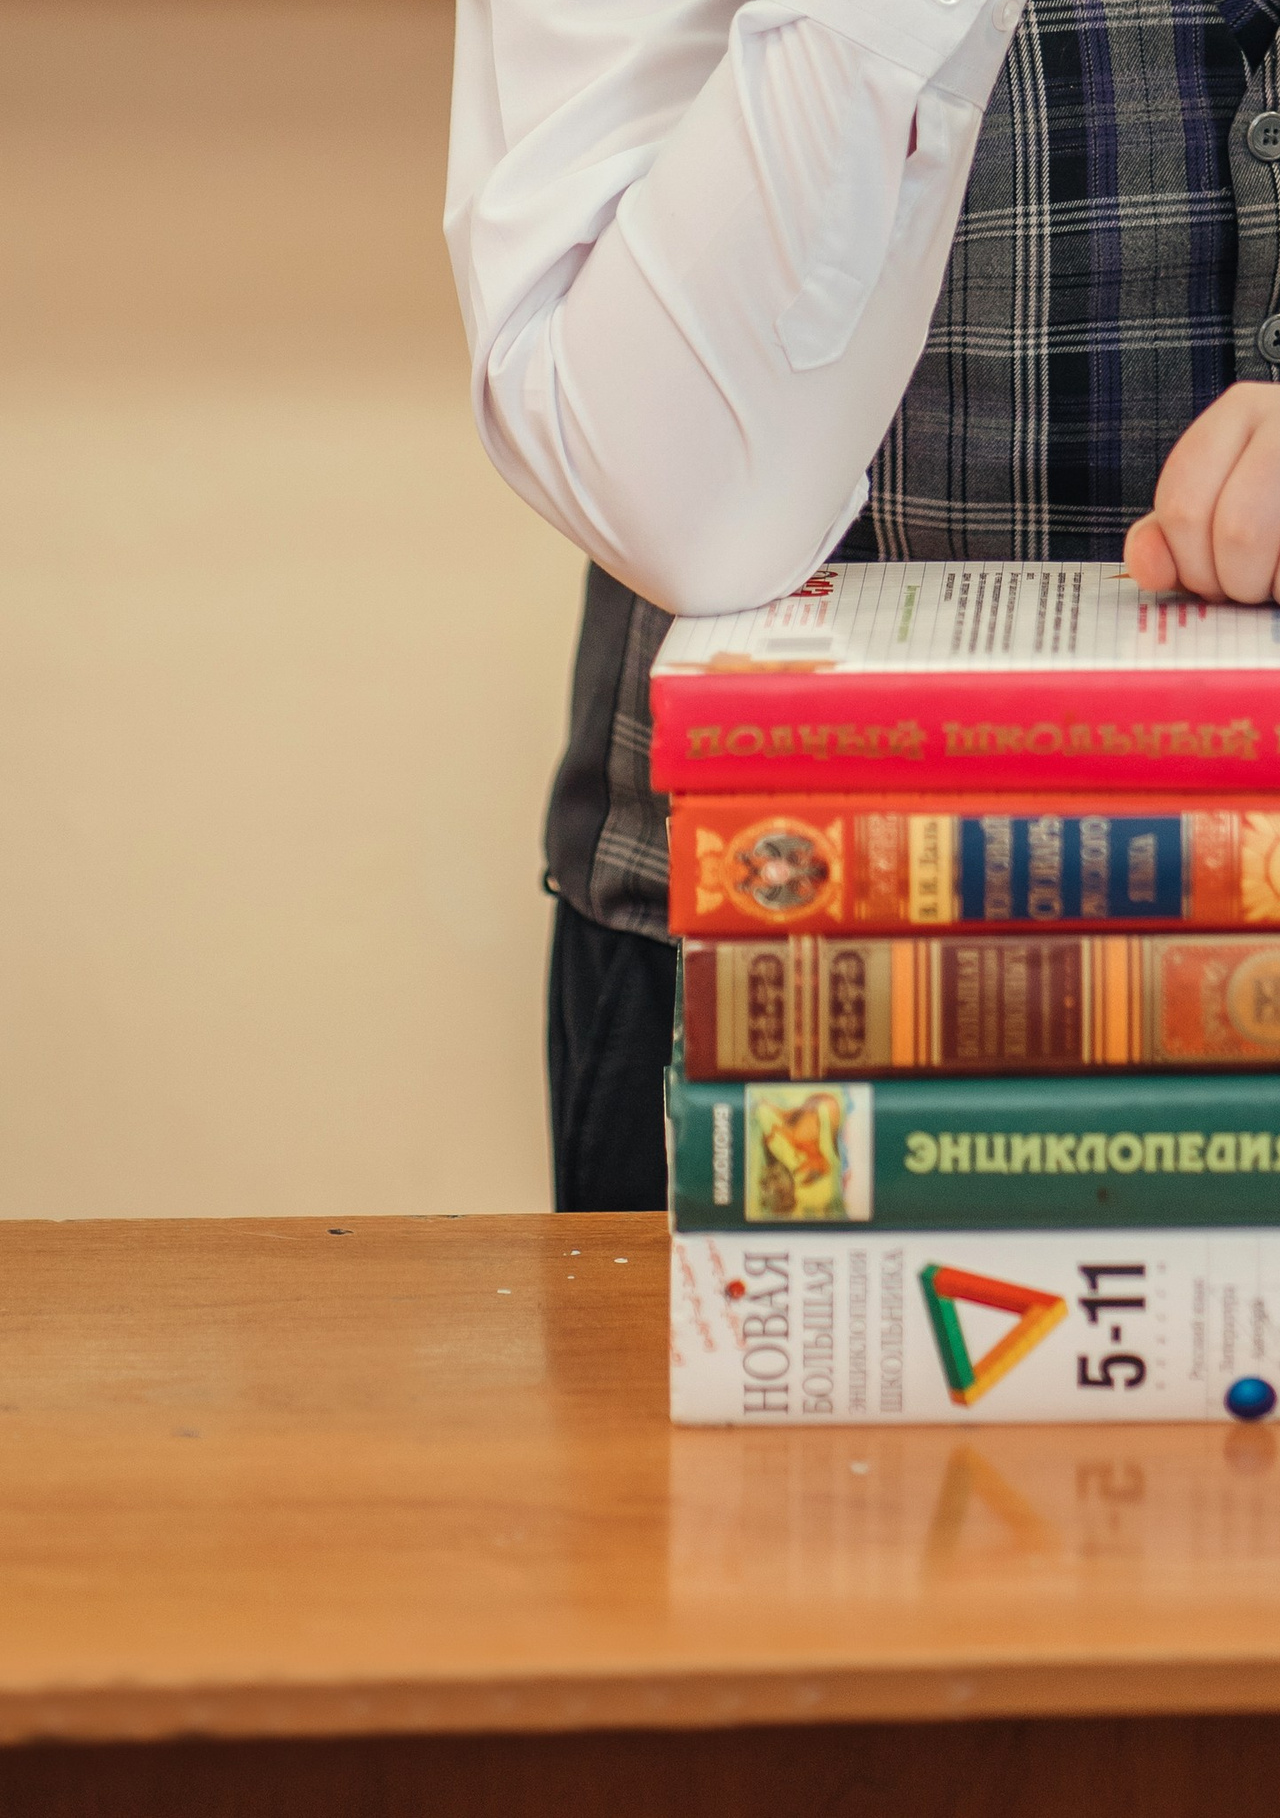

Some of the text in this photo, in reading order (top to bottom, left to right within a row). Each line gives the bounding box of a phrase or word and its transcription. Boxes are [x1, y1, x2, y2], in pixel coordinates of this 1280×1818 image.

[742, 1251, 790, 1415] НОВАЯ
[801, 1256, 835, 1415] БОЛЬШАЯ
[879, 1247, 905, 1414] ШКОЛЬНИКА
[1078, 1262, 1147, 1391] 5-11
